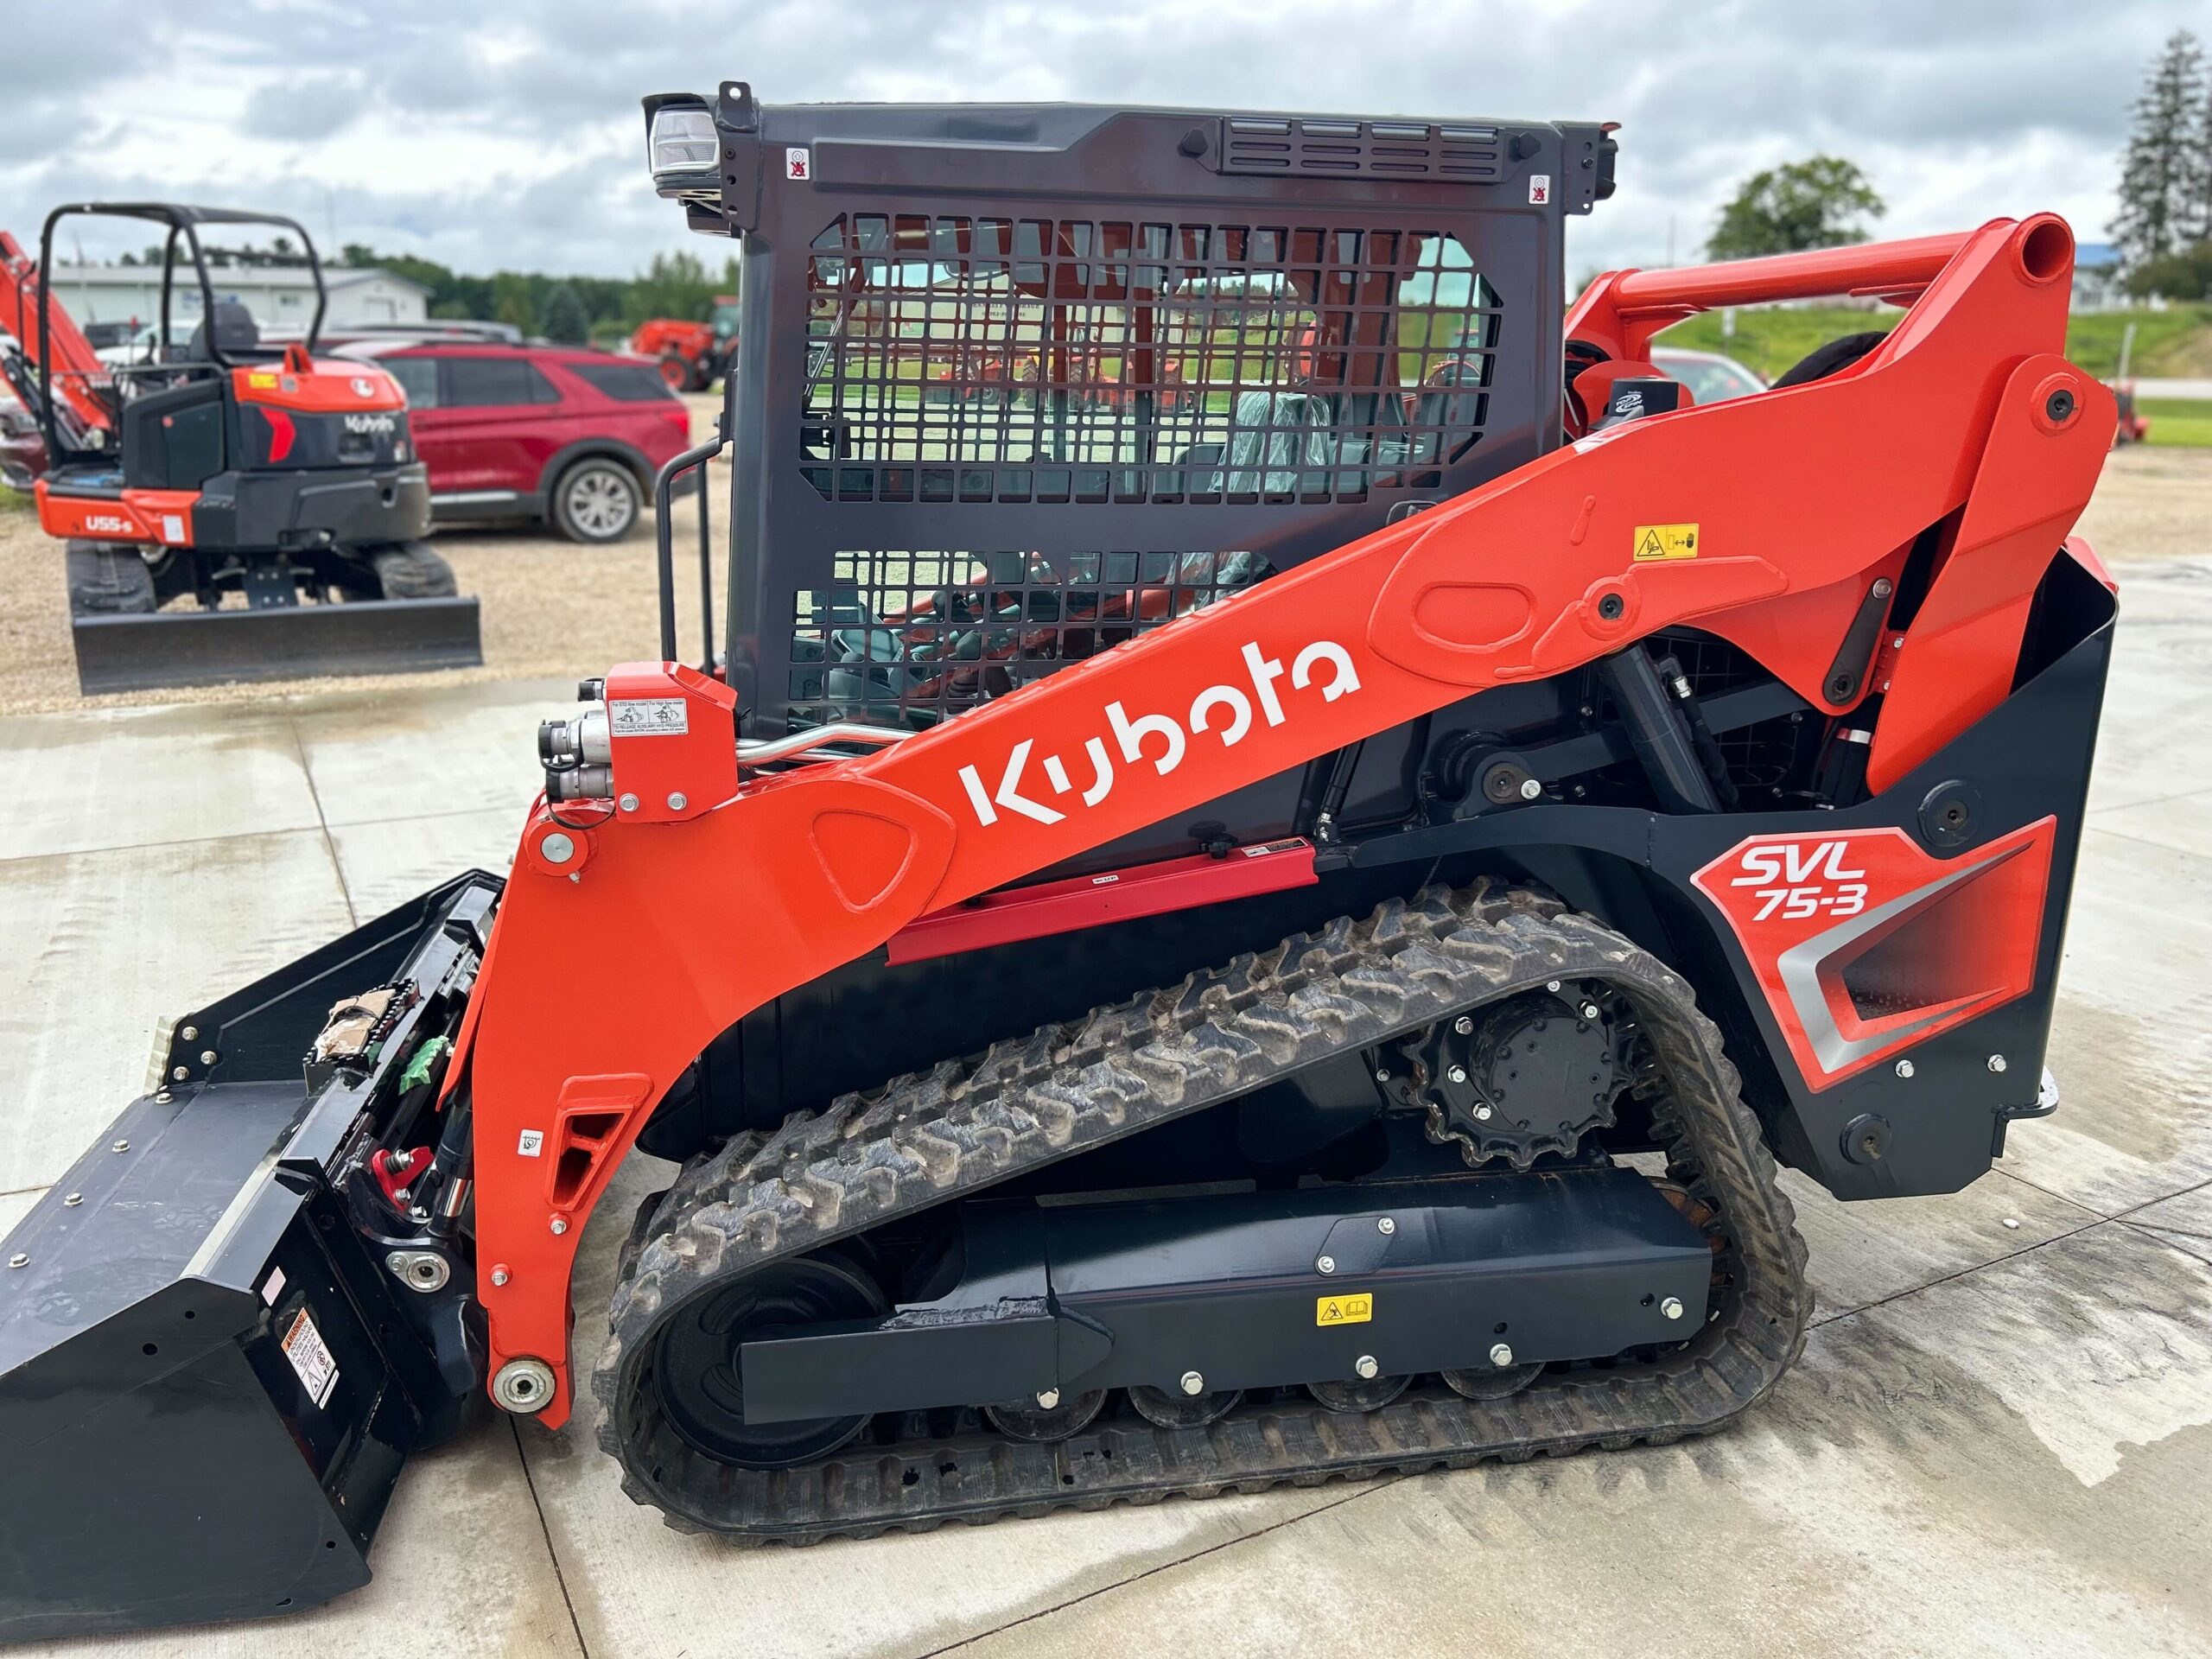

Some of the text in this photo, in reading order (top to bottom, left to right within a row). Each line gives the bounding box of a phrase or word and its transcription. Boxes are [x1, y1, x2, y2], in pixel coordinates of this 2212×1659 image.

[957, 640, 1362, 827] Kubota
[1731, 841, 1866, 887] SVL
[1751, 883, 1868, 921] 75-3
